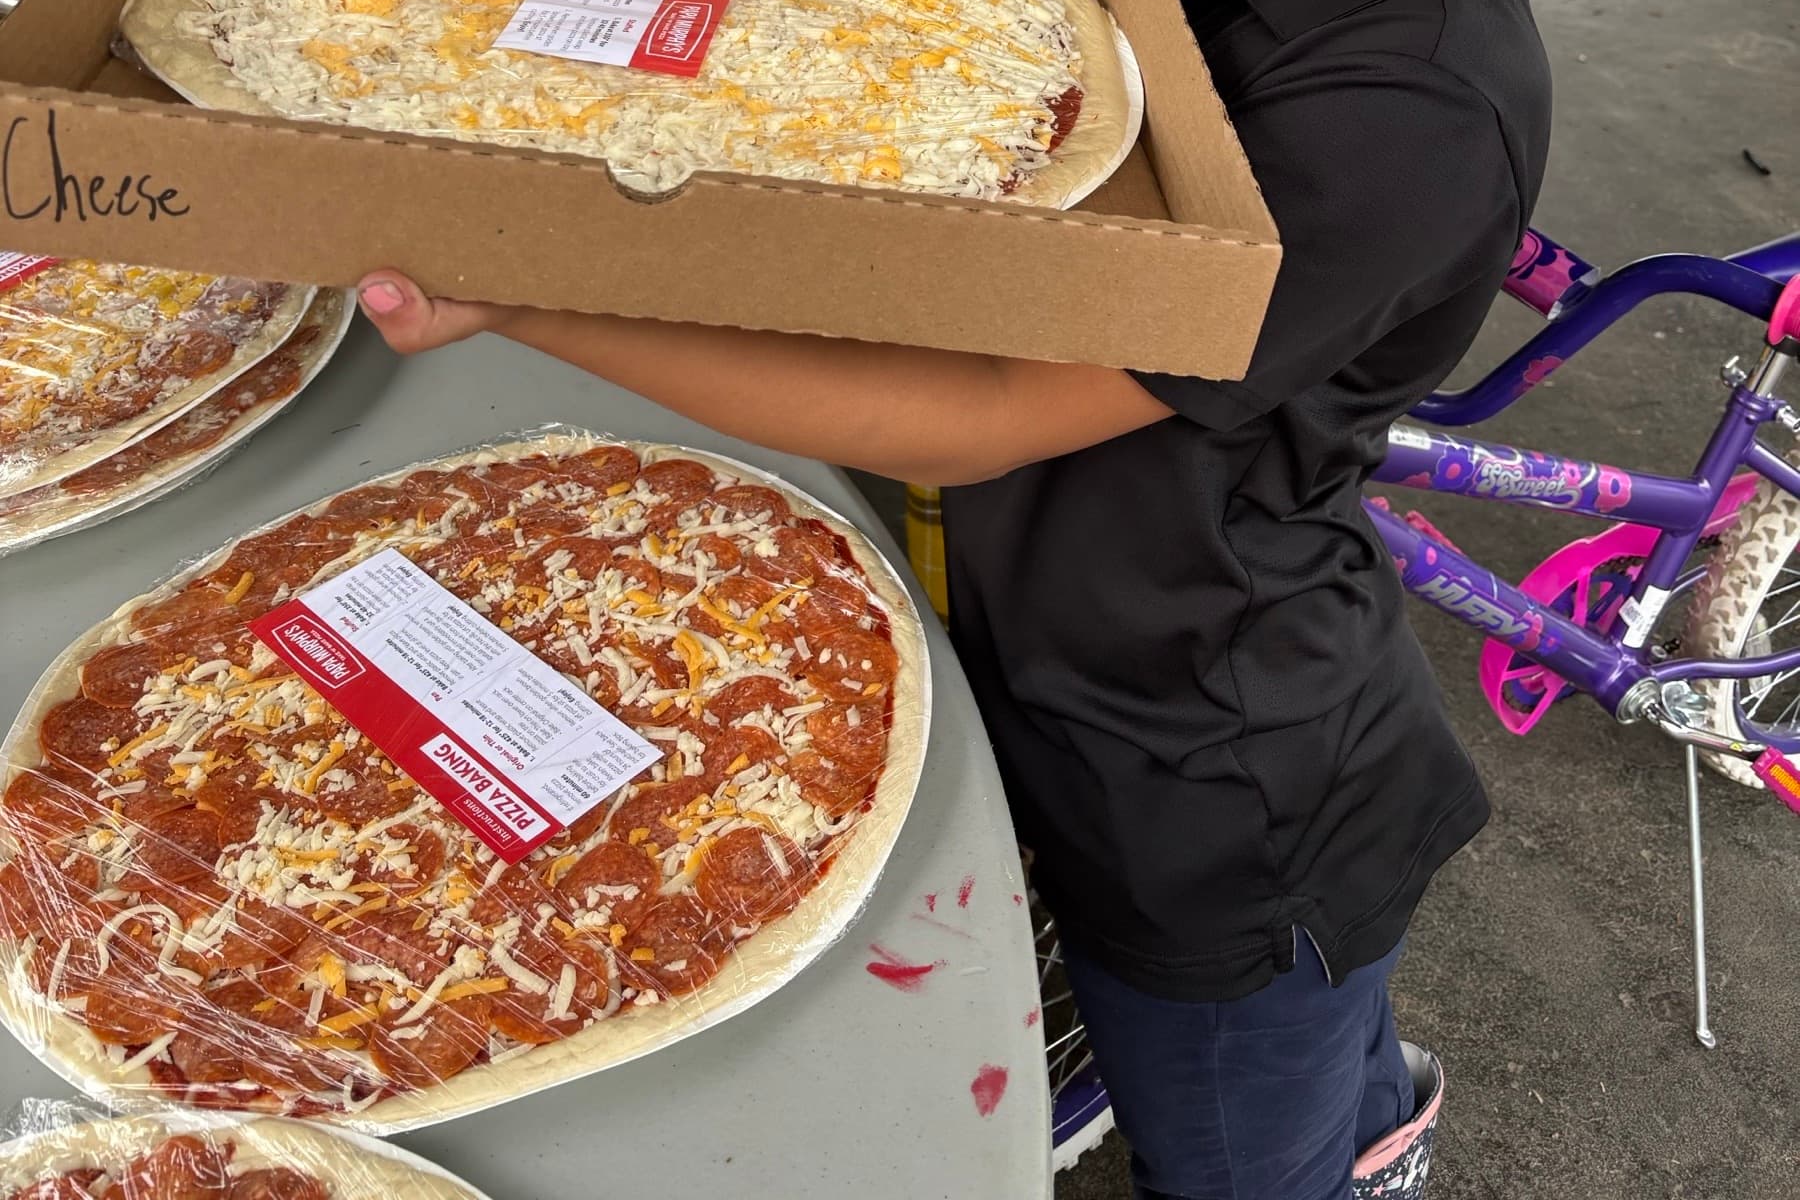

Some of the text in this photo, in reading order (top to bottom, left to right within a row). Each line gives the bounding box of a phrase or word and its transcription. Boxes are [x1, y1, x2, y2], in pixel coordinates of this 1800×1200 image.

[676, 4, 701, 19] PAPA
[659, 18, 696, 53] MURPHY'S
[3, 108, 191, 223] Cheese
[1414, 574, 1531, 636] HUFFY
[281, 623, 352, 680] PAPA MURPHY'S
[429, 691, 442, 701] Pan
[460, 699, 482, 716] minutes
[490, 724, 502, 733] for
[480, 733, 497, 746] Thin
[499, 748, 527, 770] Original
[514, 744, 530, 757] Bake
[431, 742, 535, 830] PIZZA BAKING
[559, 773, 584, 793] minutes
[460, 797, 512, 842] instructions
